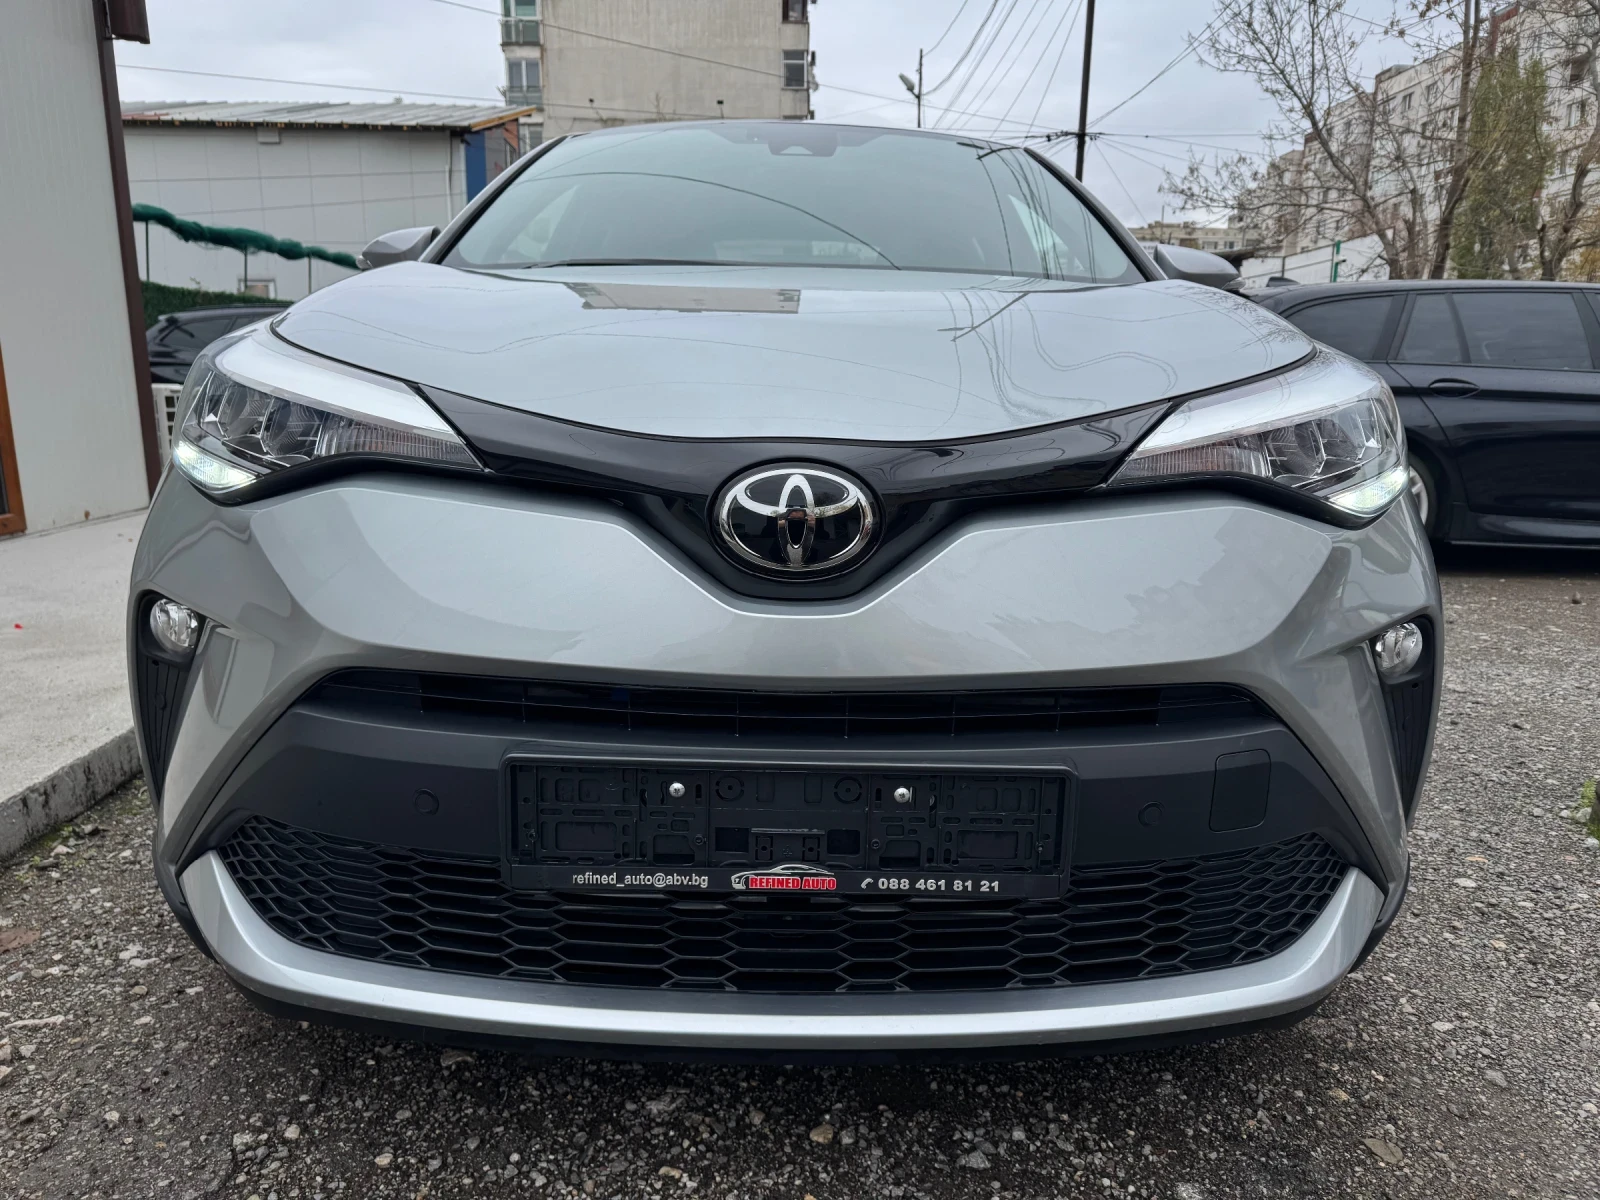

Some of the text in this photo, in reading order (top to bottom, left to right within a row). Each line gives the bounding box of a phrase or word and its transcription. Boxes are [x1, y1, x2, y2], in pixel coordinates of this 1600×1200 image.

[572, 872, 708, 888] refined_auto@abv.bg
[748, 876, 837, 890] REFINED AUTO
[878, 878, 999, 892] 088 461 81 21
